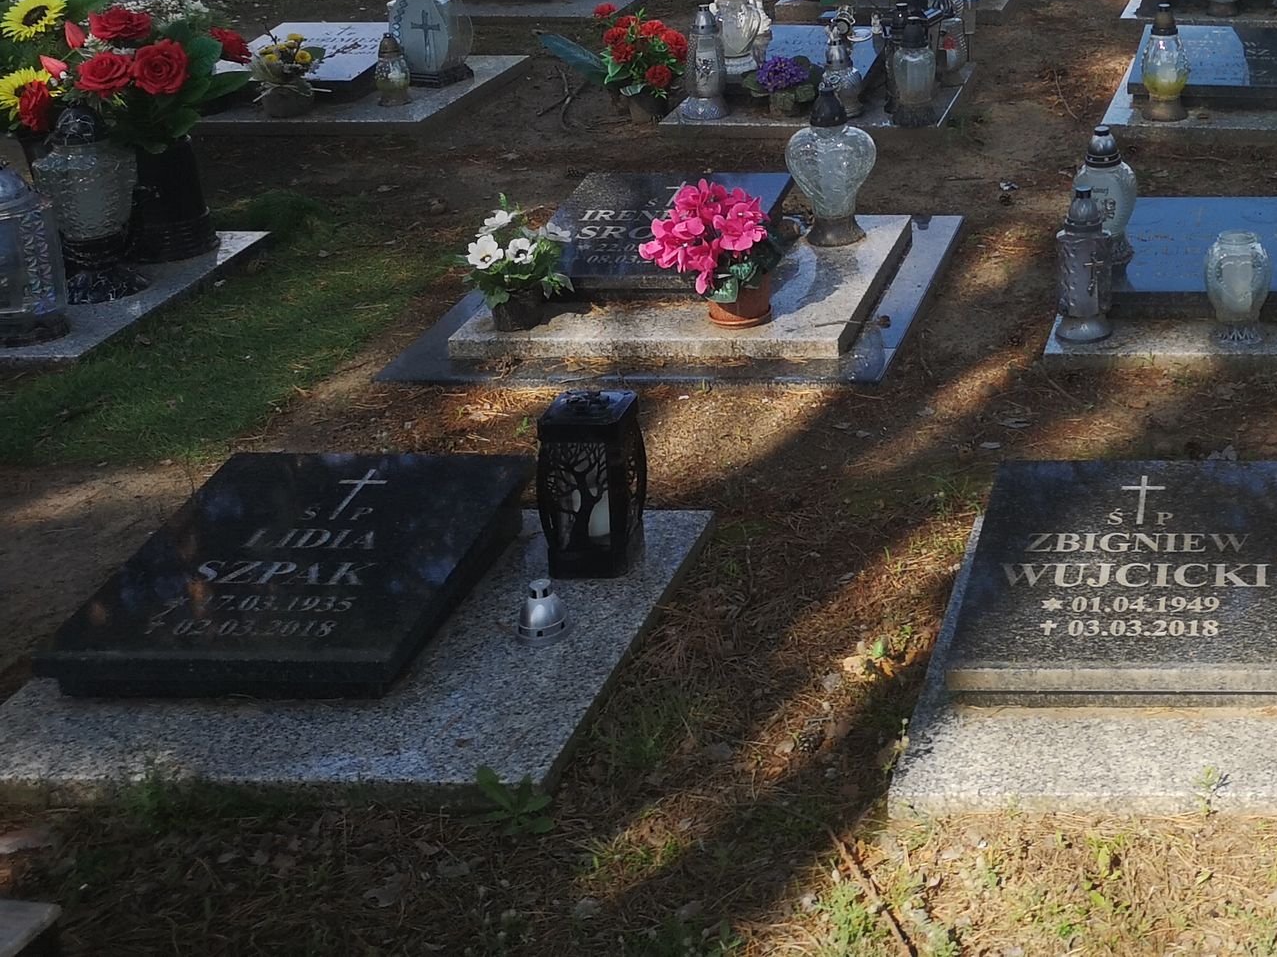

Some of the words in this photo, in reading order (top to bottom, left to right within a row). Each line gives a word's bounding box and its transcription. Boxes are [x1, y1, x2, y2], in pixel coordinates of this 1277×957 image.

[575, 226, 654, 239] SRO
[1106, 507, 1124, 526] Ś
[1154, 511, 1174, 527] P
[242, 528, 377, 549] LIDIA
[1023, 532, 1252, 553] ZBIGNIEW
[197, 559, 379, 586] SZPAK
[1001, 562, 1272, 588] WUJCICKI
[1070, 596, 1221, 613] 01.04.1949
[1067, 619, 1220, 638] 03.03.2018
